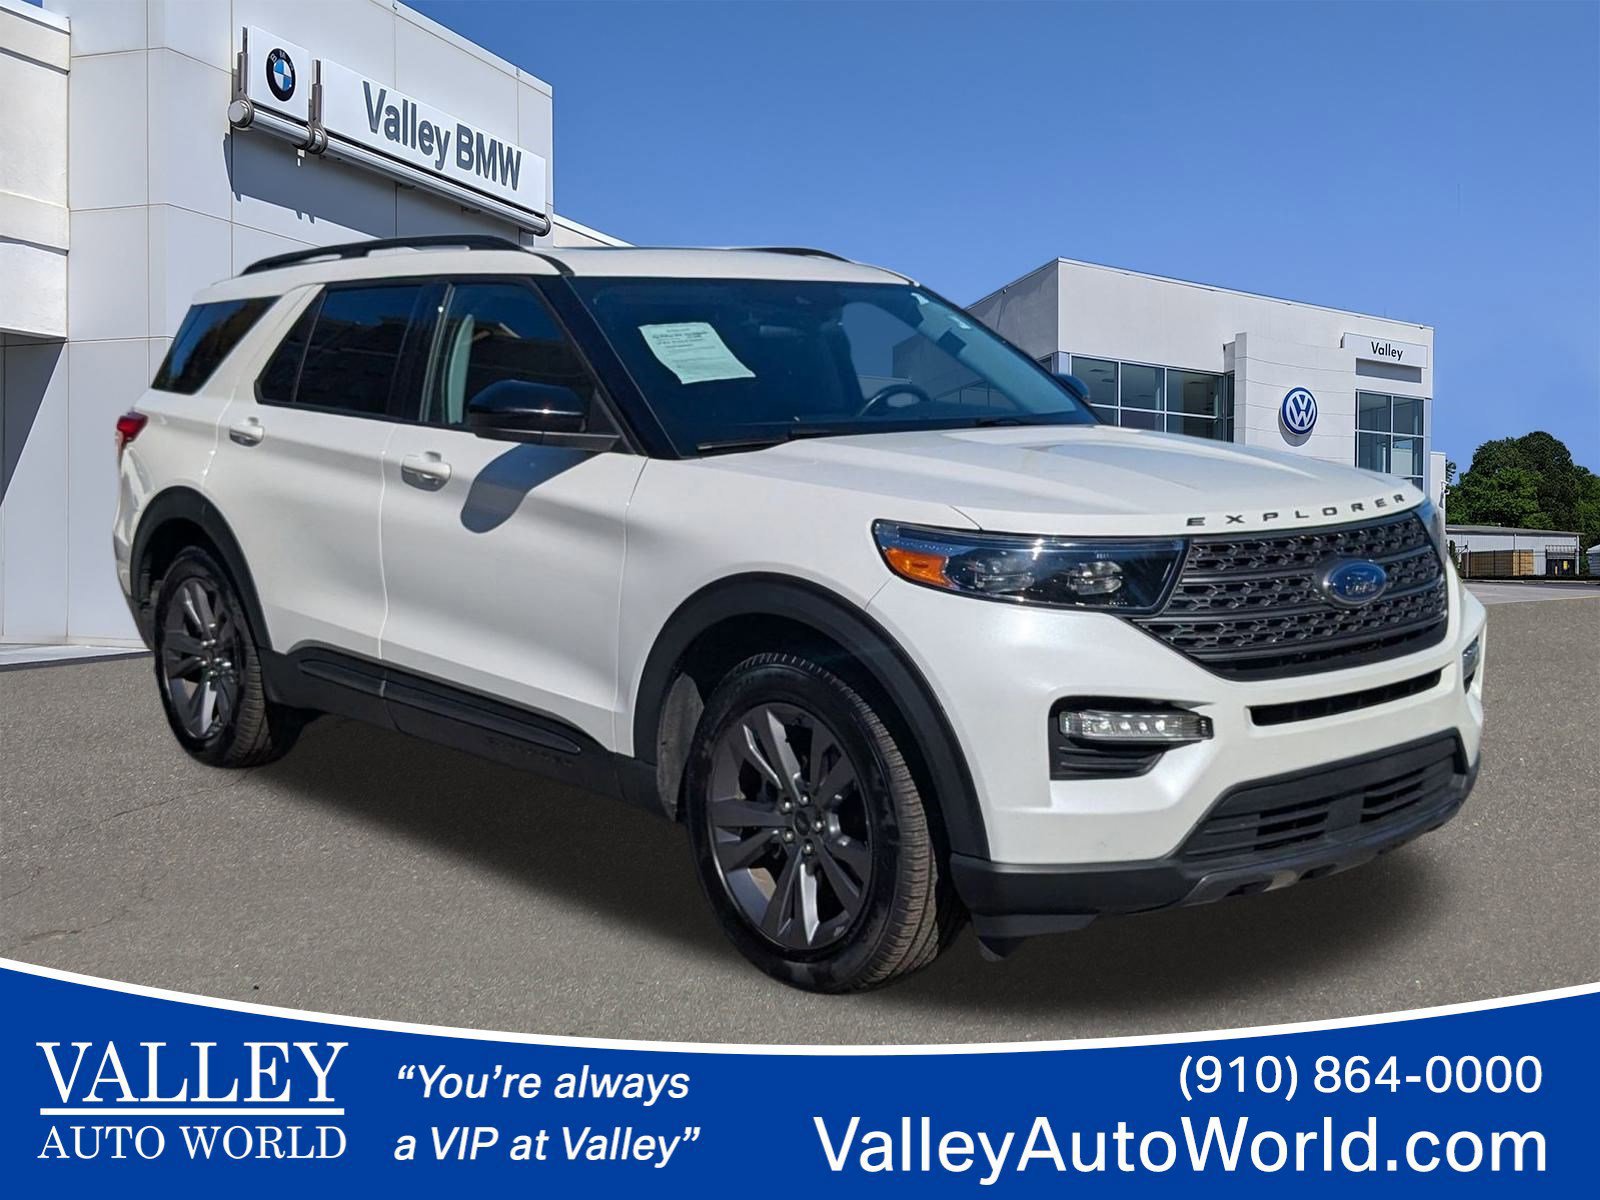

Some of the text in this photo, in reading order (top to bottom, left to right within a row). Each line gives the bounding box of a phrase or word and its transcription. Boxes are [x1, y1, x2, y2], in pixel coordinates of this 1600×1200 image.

[362, 80, 522, 191] Valley BMW
[1371, 341, 1403, 361] Valley
[1186, 493, 1406, 526] EXPLORER
